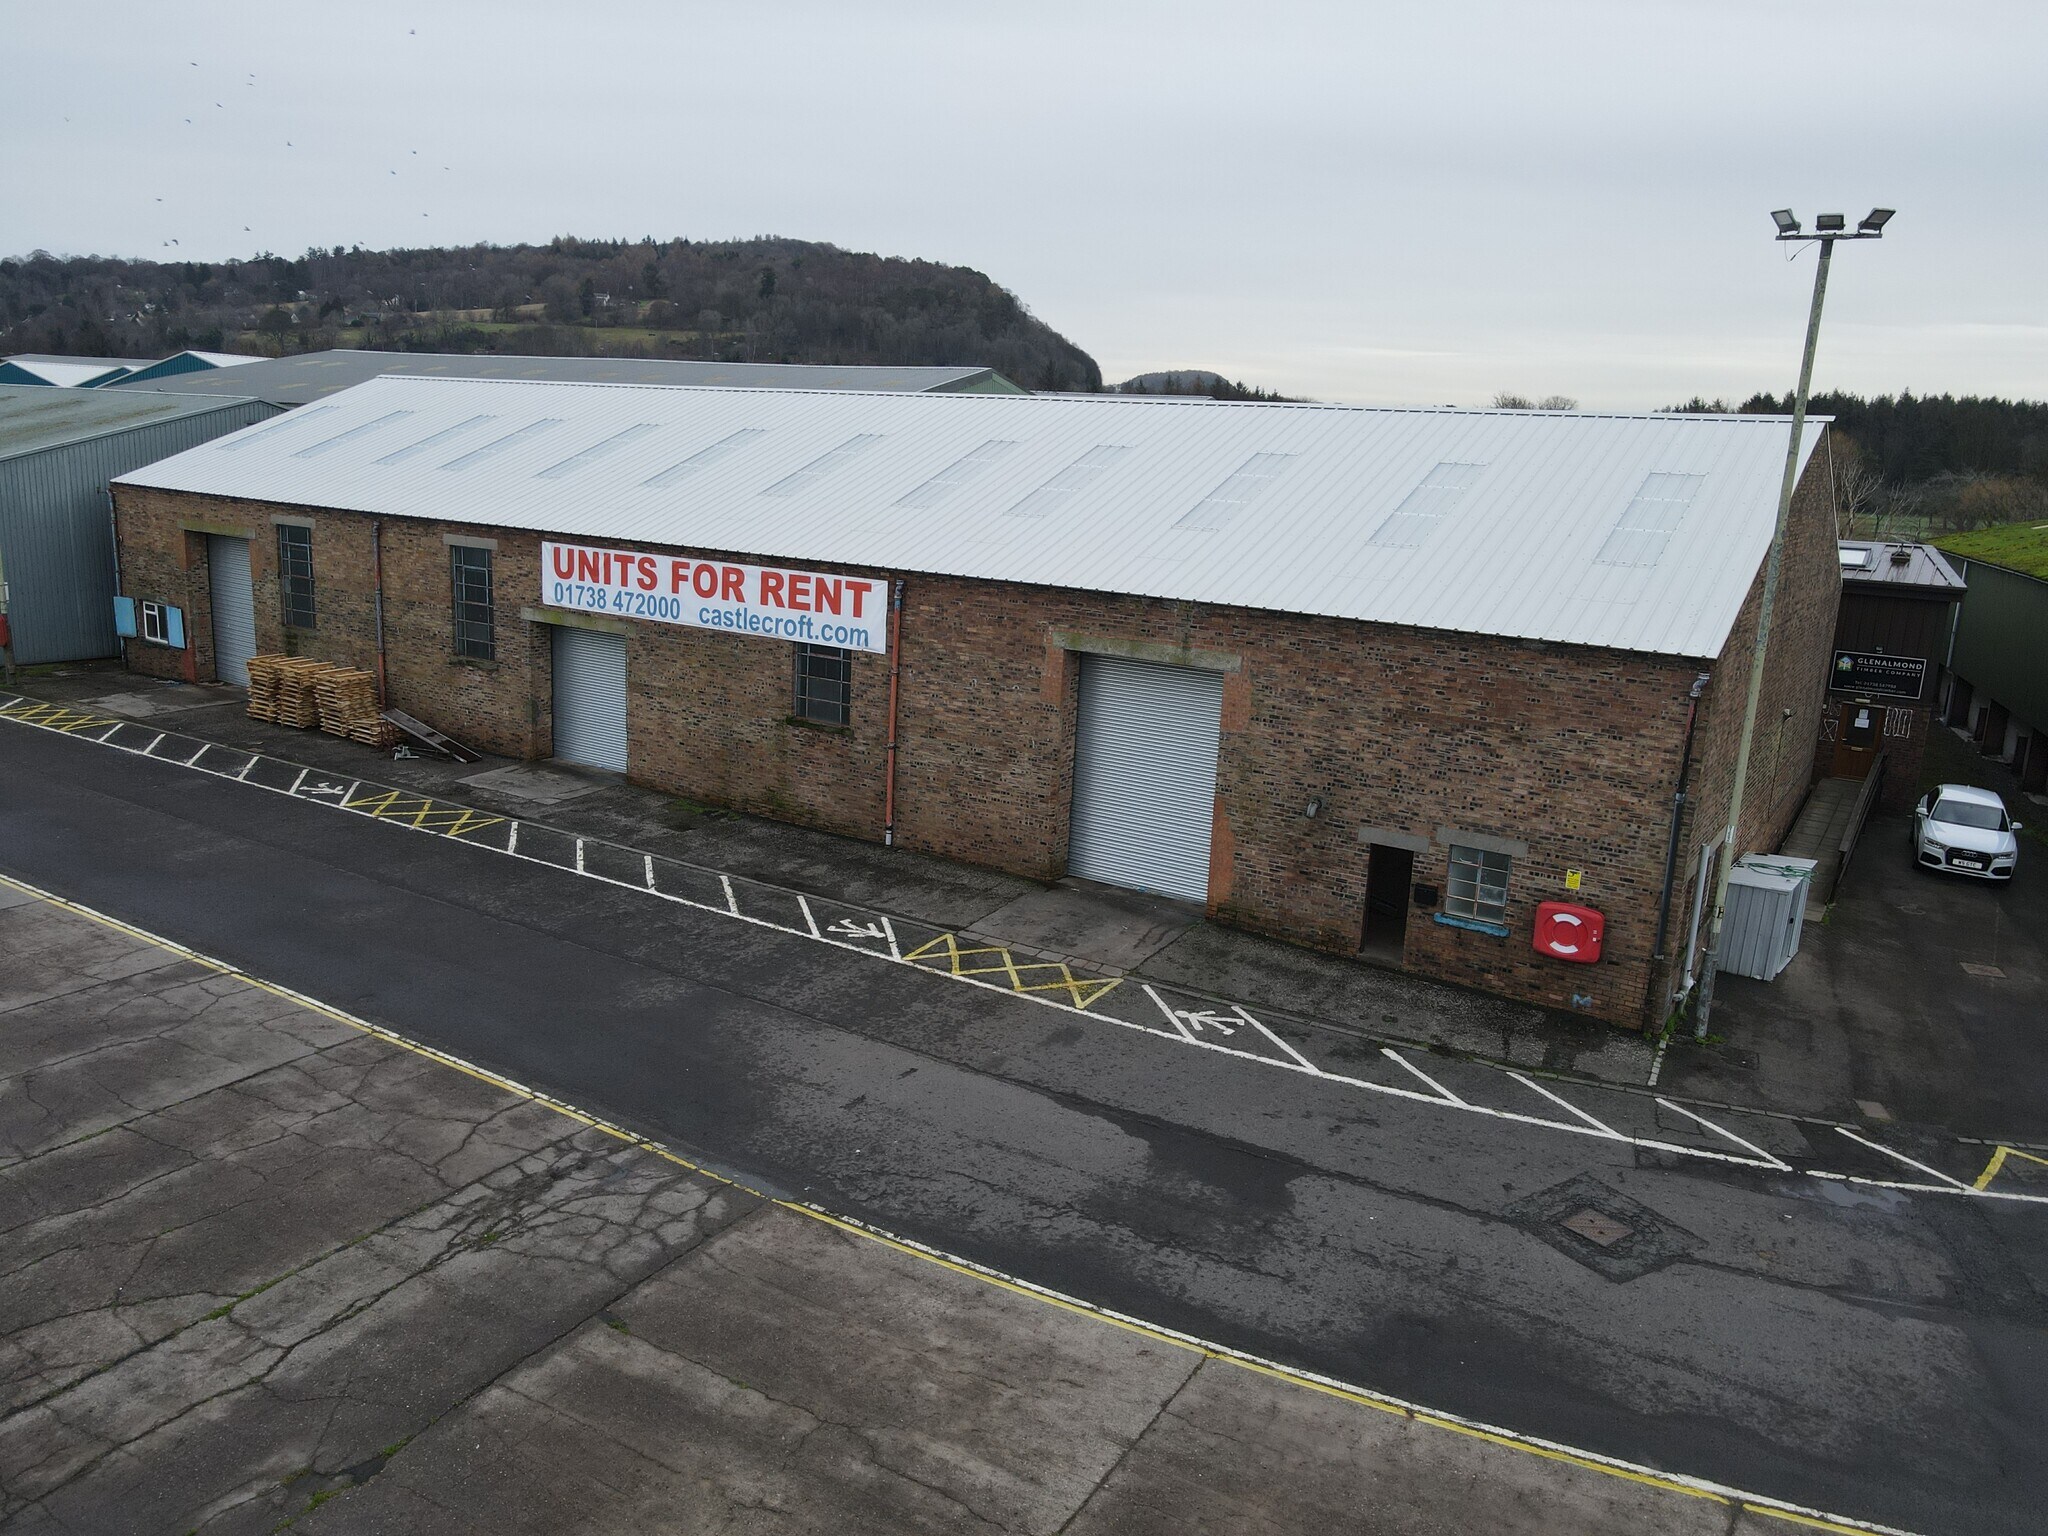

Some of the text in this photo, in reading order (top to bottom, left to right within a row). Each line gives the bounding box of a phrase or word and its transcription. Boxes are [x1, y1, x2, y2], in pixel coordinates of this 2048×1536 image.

[553, 546, 872, 618] UNITS FOR RENT
[554, 582, 869, 647] 01738 472000 castlecroft.com
[1857, 658, 1922, 670] GLENALMOND
